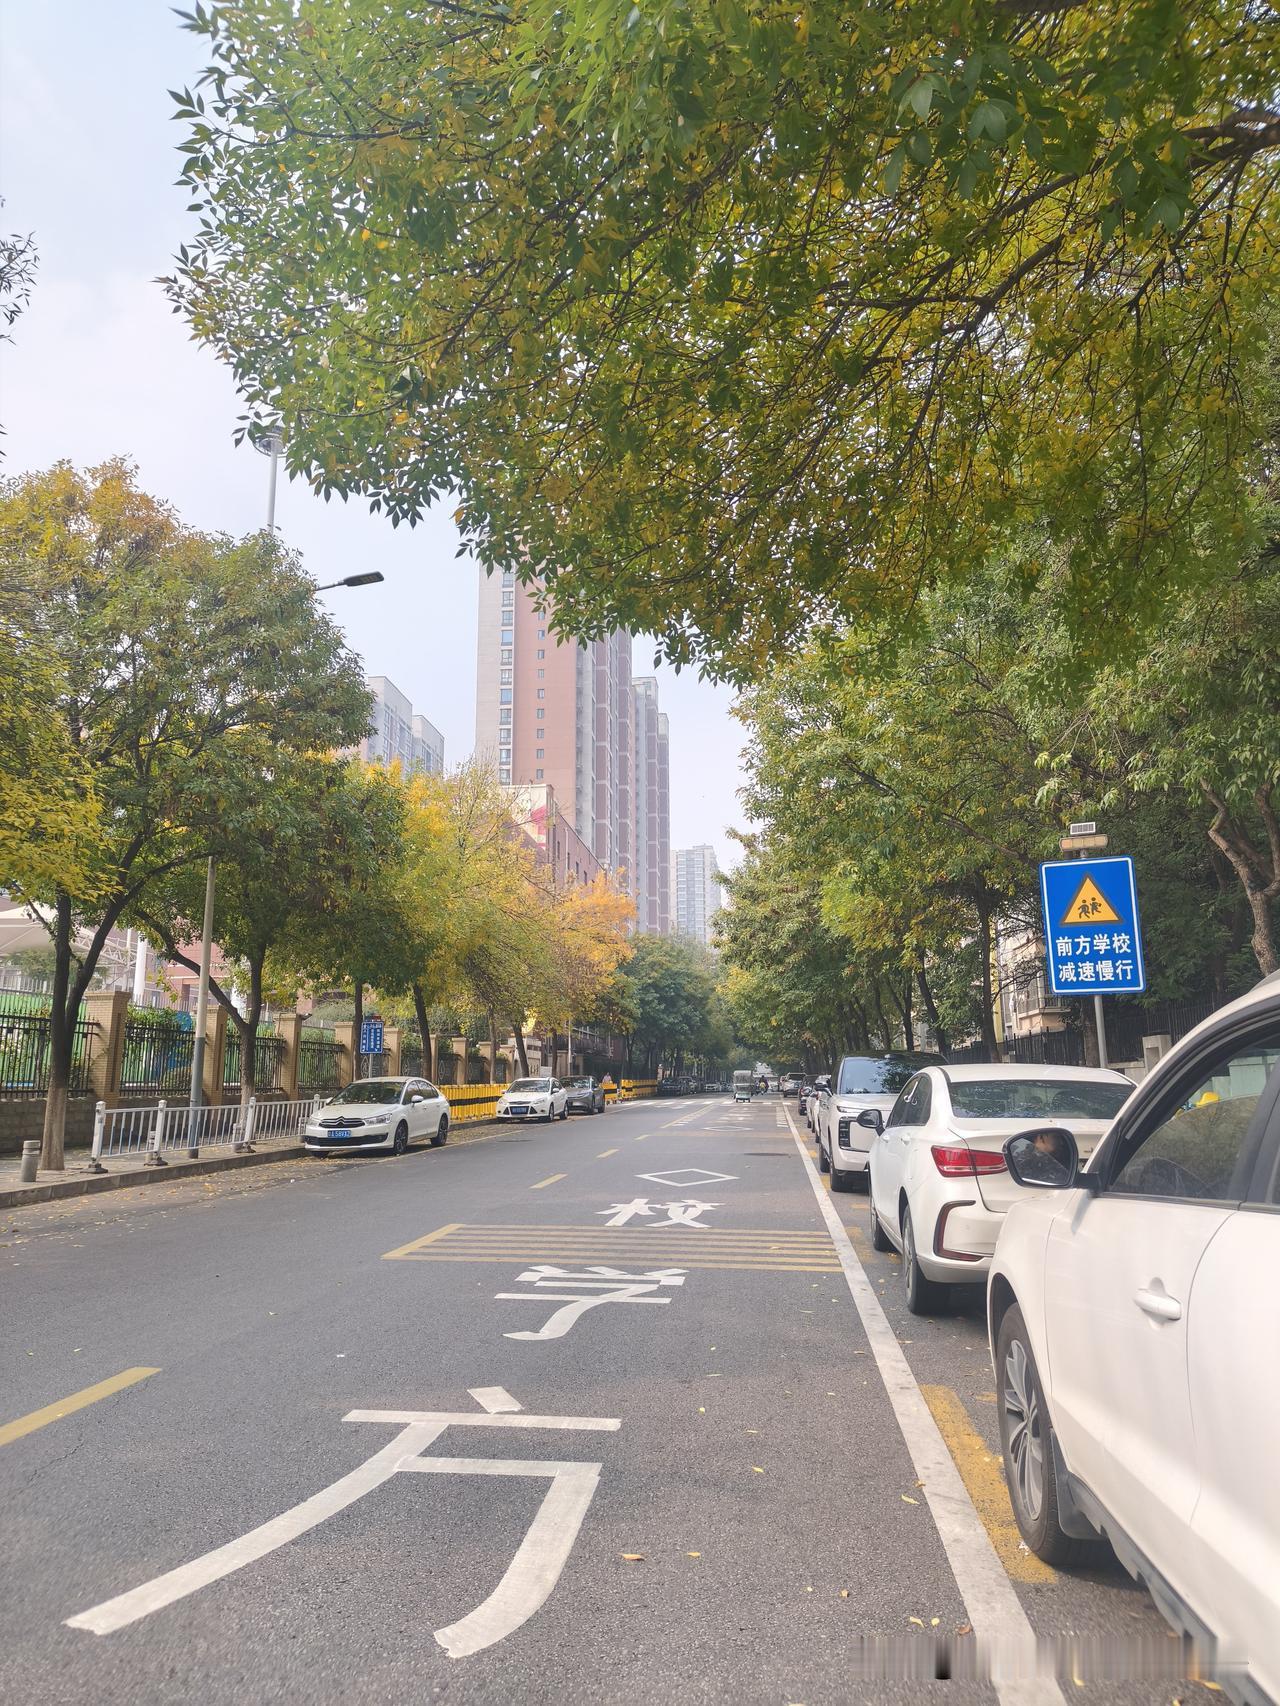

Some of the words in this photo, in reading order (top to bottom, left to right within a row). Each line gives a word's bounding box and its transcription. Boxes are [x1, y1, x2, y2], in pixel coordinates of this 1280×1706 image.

[1055, 933, 1131, 957] 前方学校
[1058, 959, 1133, 982] 减速慢行
